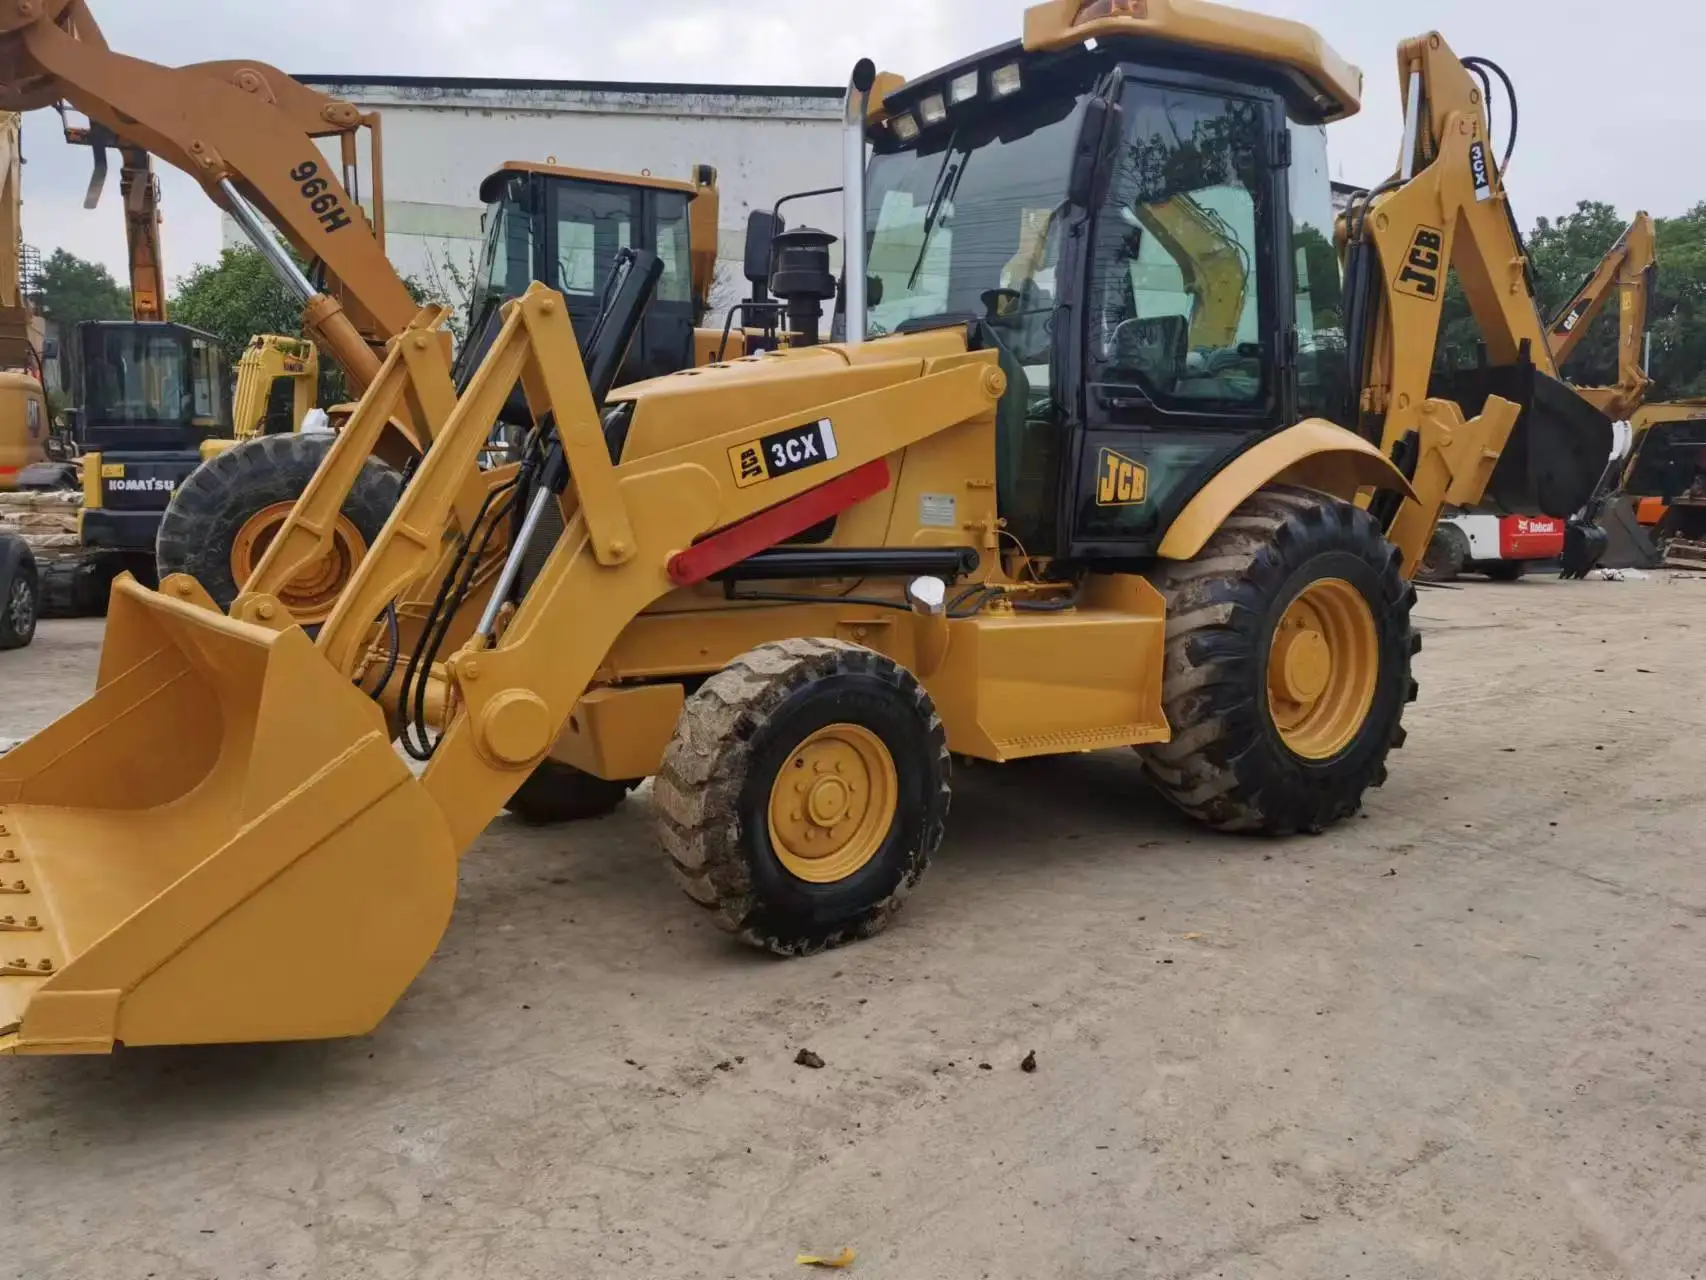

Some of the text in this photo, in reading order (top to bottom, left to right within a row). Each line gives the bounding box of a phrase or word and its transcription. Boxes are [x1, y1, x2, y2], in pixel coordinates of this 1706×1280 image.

[1471, 145, 1486, 185] 3CX
[291, 161, 352, 233] 966H
[1399, 231, 1441, 296] JCB
[1563, 309, 1579, 330] CAT
[740, 447, 762, 479] JCB
[771, 433, 819, 467] 3CX
[108, 477, 175, 491] KOMATSU
[1100, 454, 1145, 501] JCB
